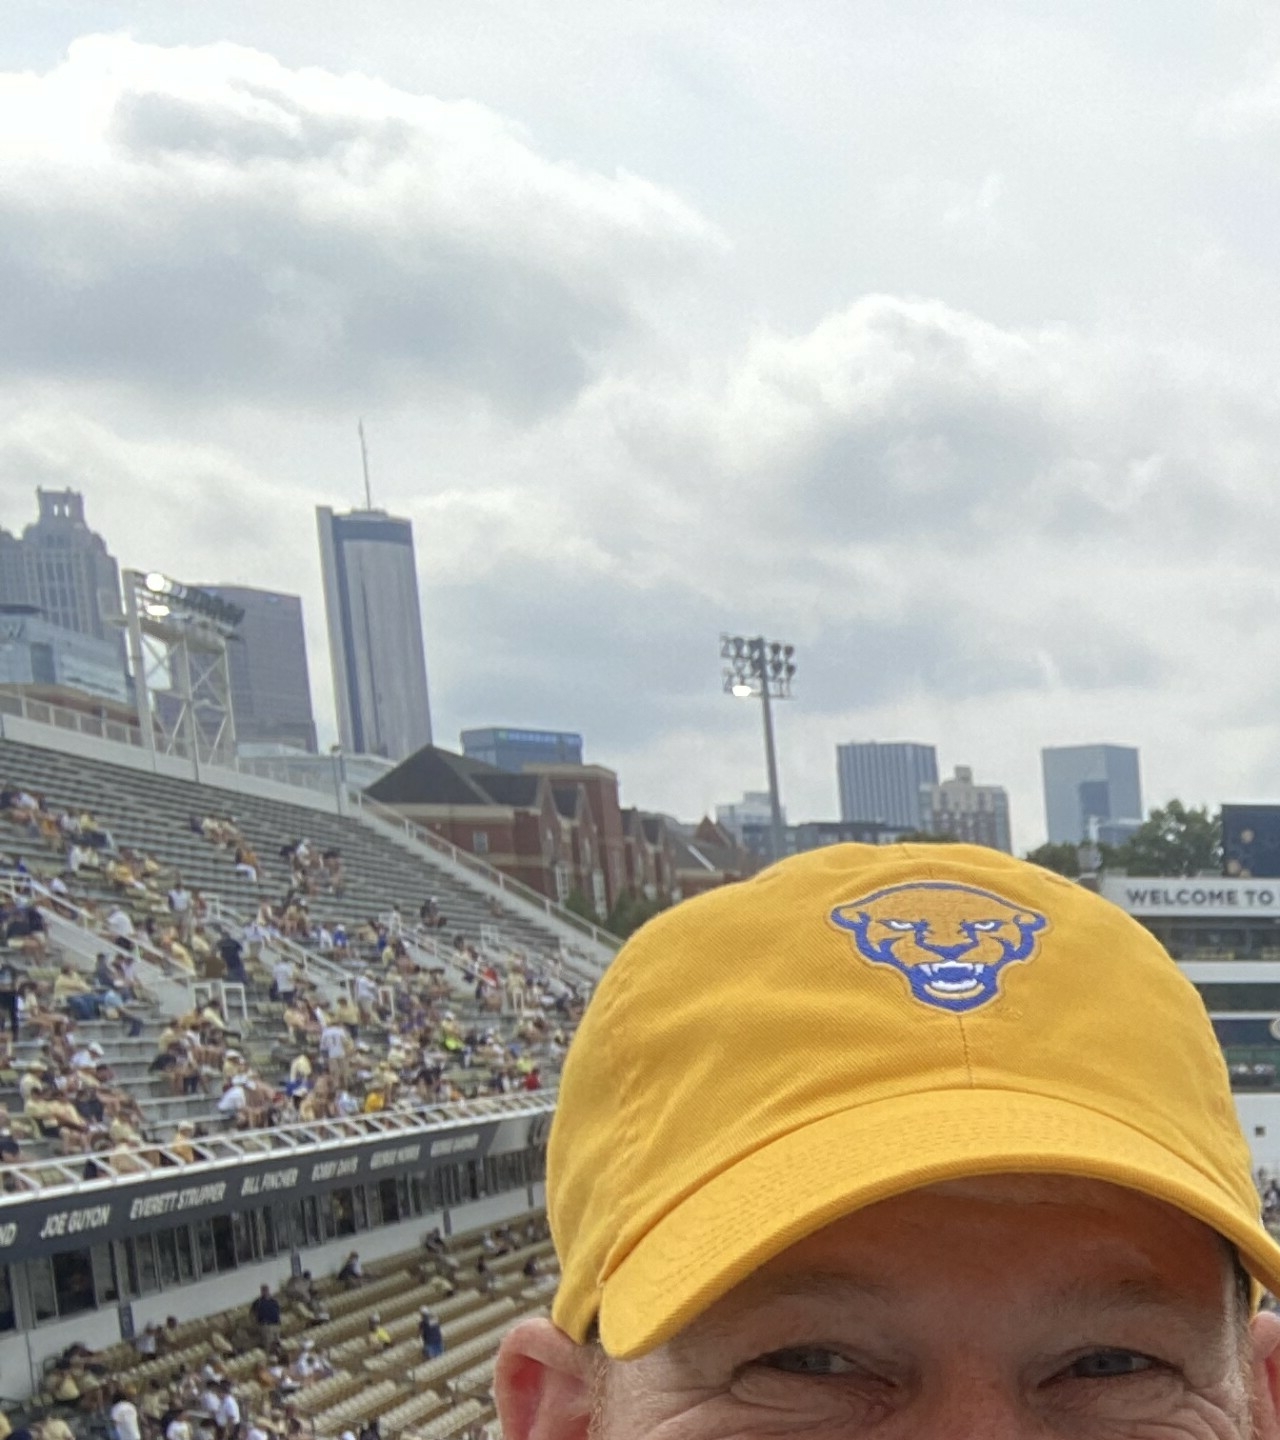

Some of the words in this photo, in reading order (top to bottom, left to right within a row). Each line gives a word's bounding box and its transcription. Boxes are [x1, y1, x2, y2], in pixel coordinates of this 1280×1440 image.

[1126, 889, 1238, 908] WELCOME
[1245, 889, 1271, 908] TO
[129, 1191, 179, 1220] EVERETT
[40, 1211, 69, 1240] JOE
[68, 1204, 111, 1233] GUYON
